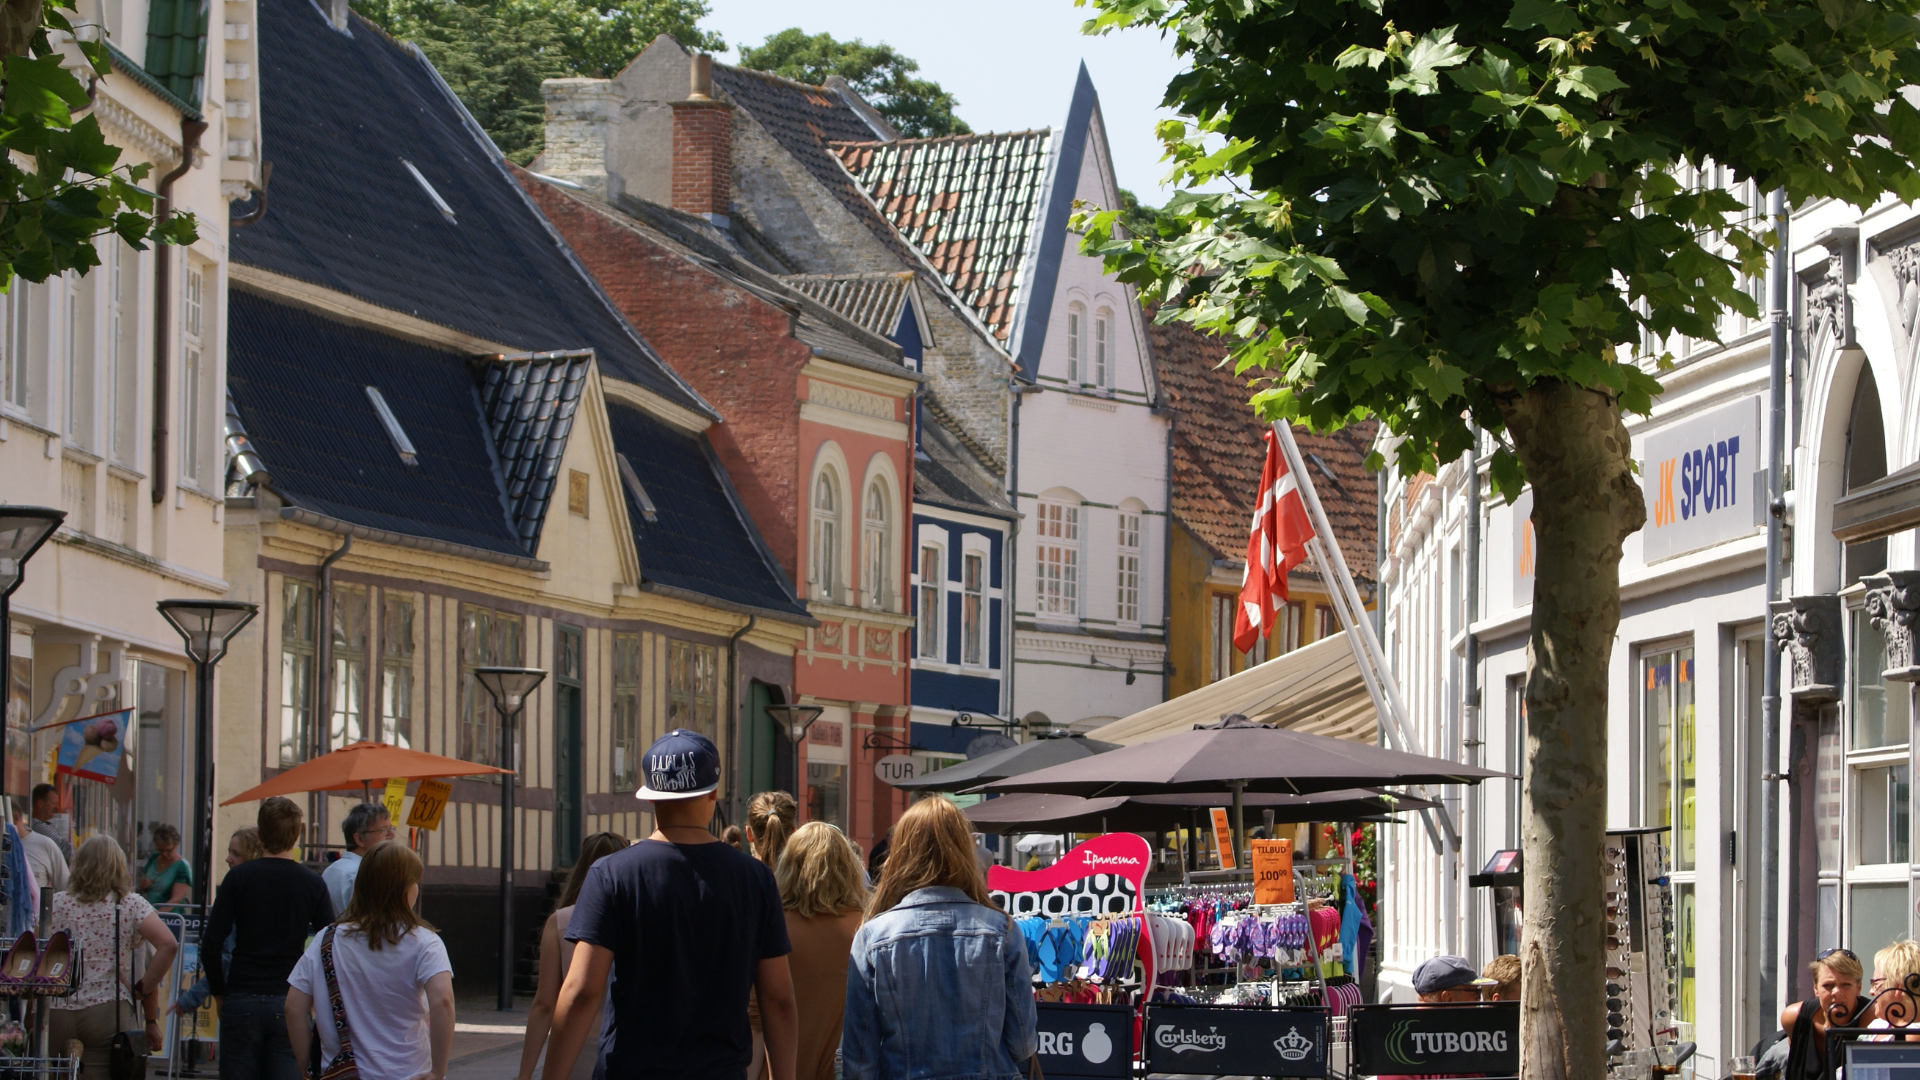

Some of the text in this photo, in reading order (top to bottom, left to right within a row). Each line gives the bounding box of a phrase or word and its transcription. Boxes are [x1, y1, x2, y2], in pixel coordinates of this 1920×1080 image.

[1655, 435, 1740, 528] JK SPORT
[881, 763, 914, 779] TUR
[1082, 850, 1140, 870] Ipanema
[1257, 846, 1287, 854] TILBUD
[1037, 1031, 1073, 1056] RG
[1154, 1024, 1226, 1053] Carlsberg
[1410, 1030, 1508, 1055] TUBORG
